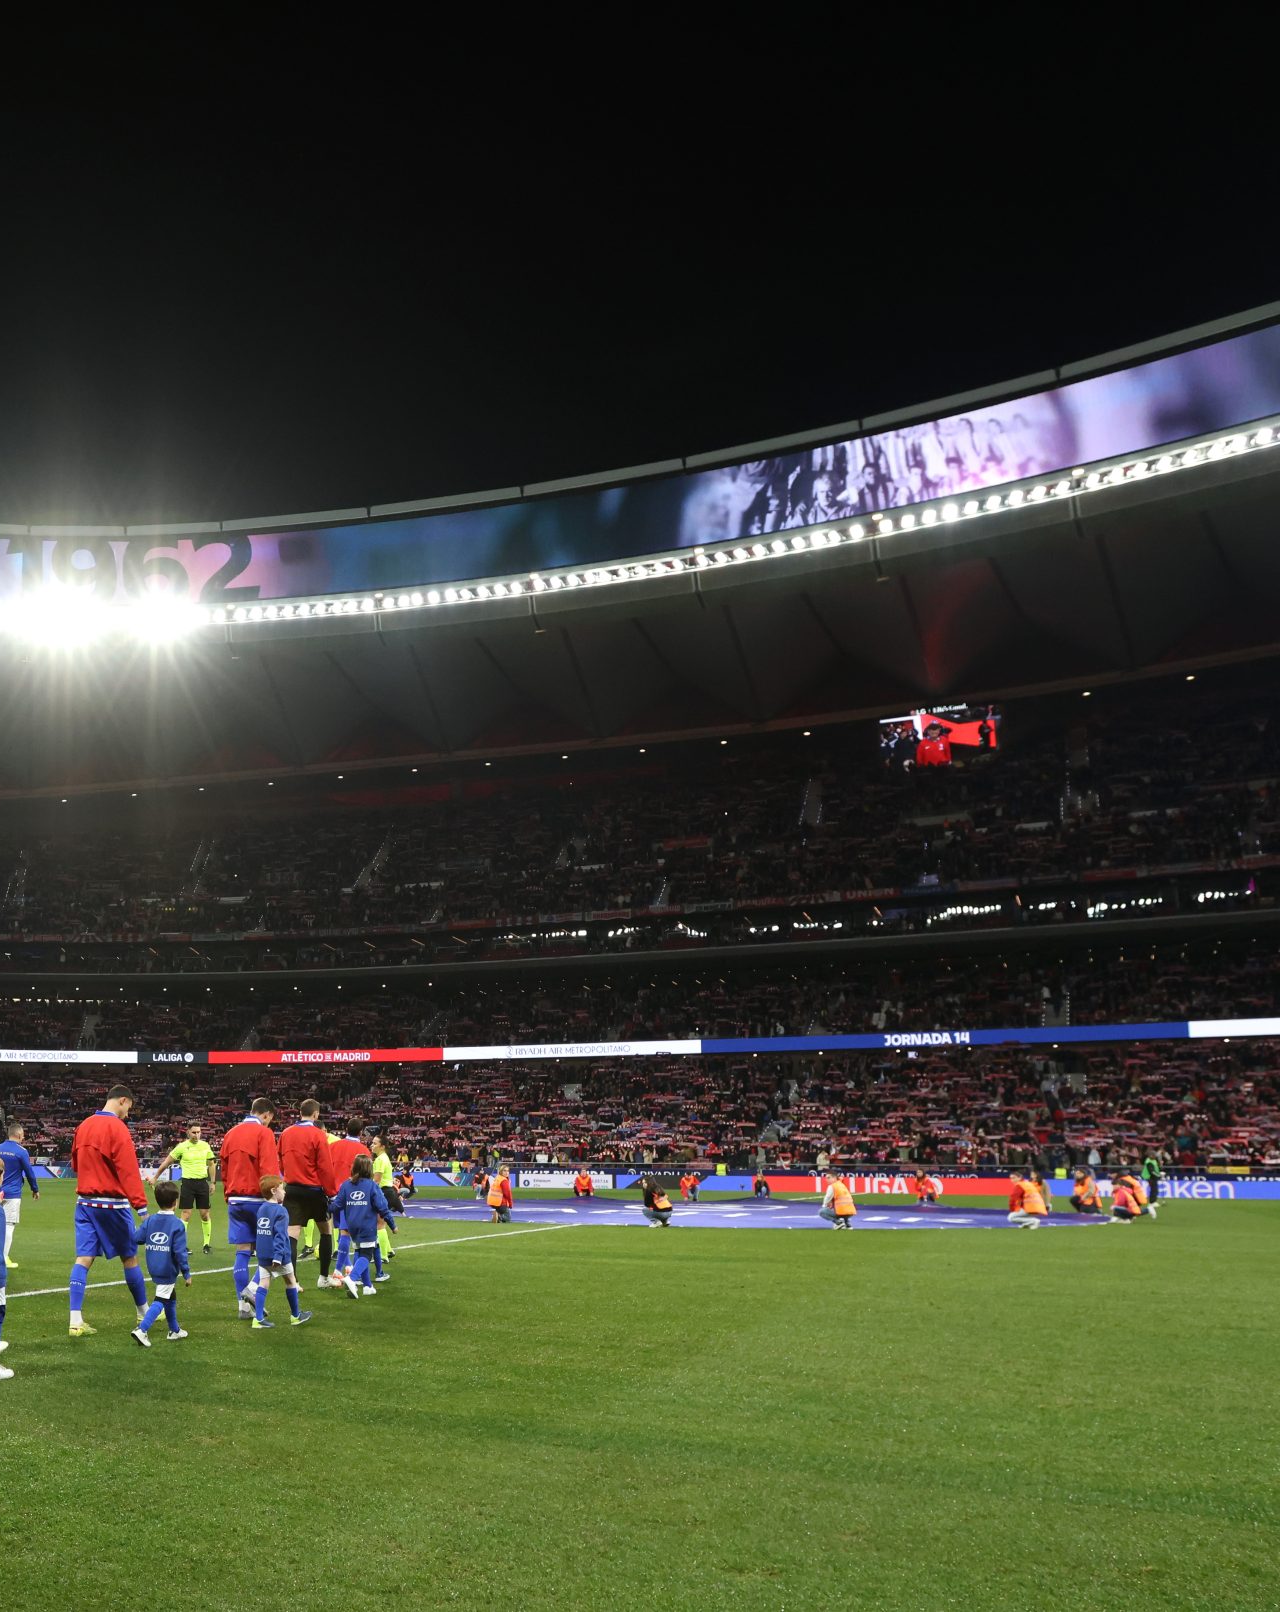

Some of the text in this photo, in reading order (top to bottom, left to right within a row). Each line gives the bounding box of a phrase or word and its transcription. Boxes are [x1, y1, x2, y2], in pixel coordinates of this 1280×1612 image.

[884, 1031, 970, 1047] JORNADA 14
[4, 1051, 17, 1060] AIR
[19, 1052, 79, 1061] METROPOLITANO
[281, 1050, 324, 1062] ATLÉTICO
[333, 1052, 371, 1062] MADRID
[515, 1044, 631, 1056] RIYADH AIR METROPOLITANO
[152, 1053, 183, 1062] LALIGA
[816, 1176, 910, 1194] LLIGA
[145, 1243, 170, 1252] HYUNDAI
